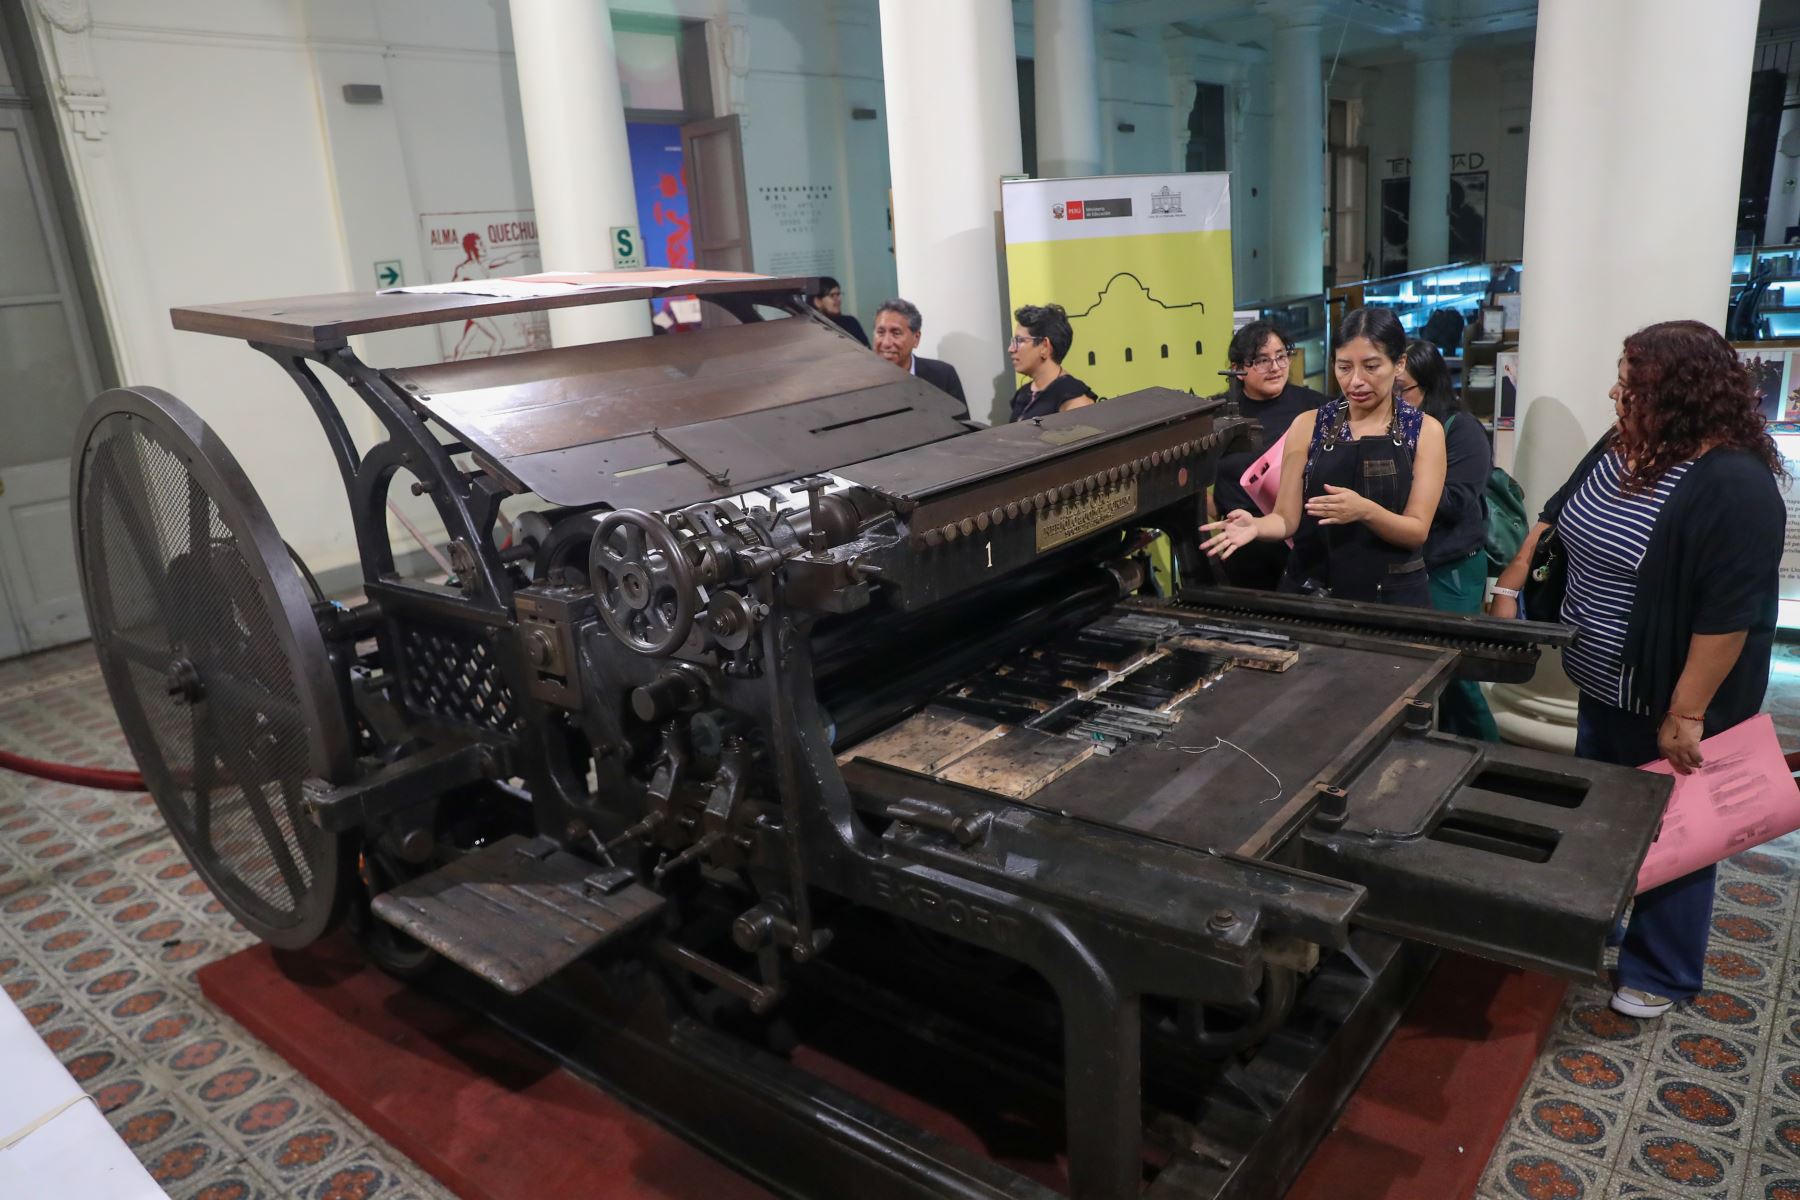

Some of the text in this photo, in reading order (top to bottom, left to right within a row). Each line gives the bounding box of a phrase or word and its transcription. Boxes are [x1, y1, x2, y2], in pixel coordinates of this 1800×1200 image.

[430, 228, 459, 246] ALMA
[616, 229, 634, 257] S
[985, 541, 993, 568] 1
